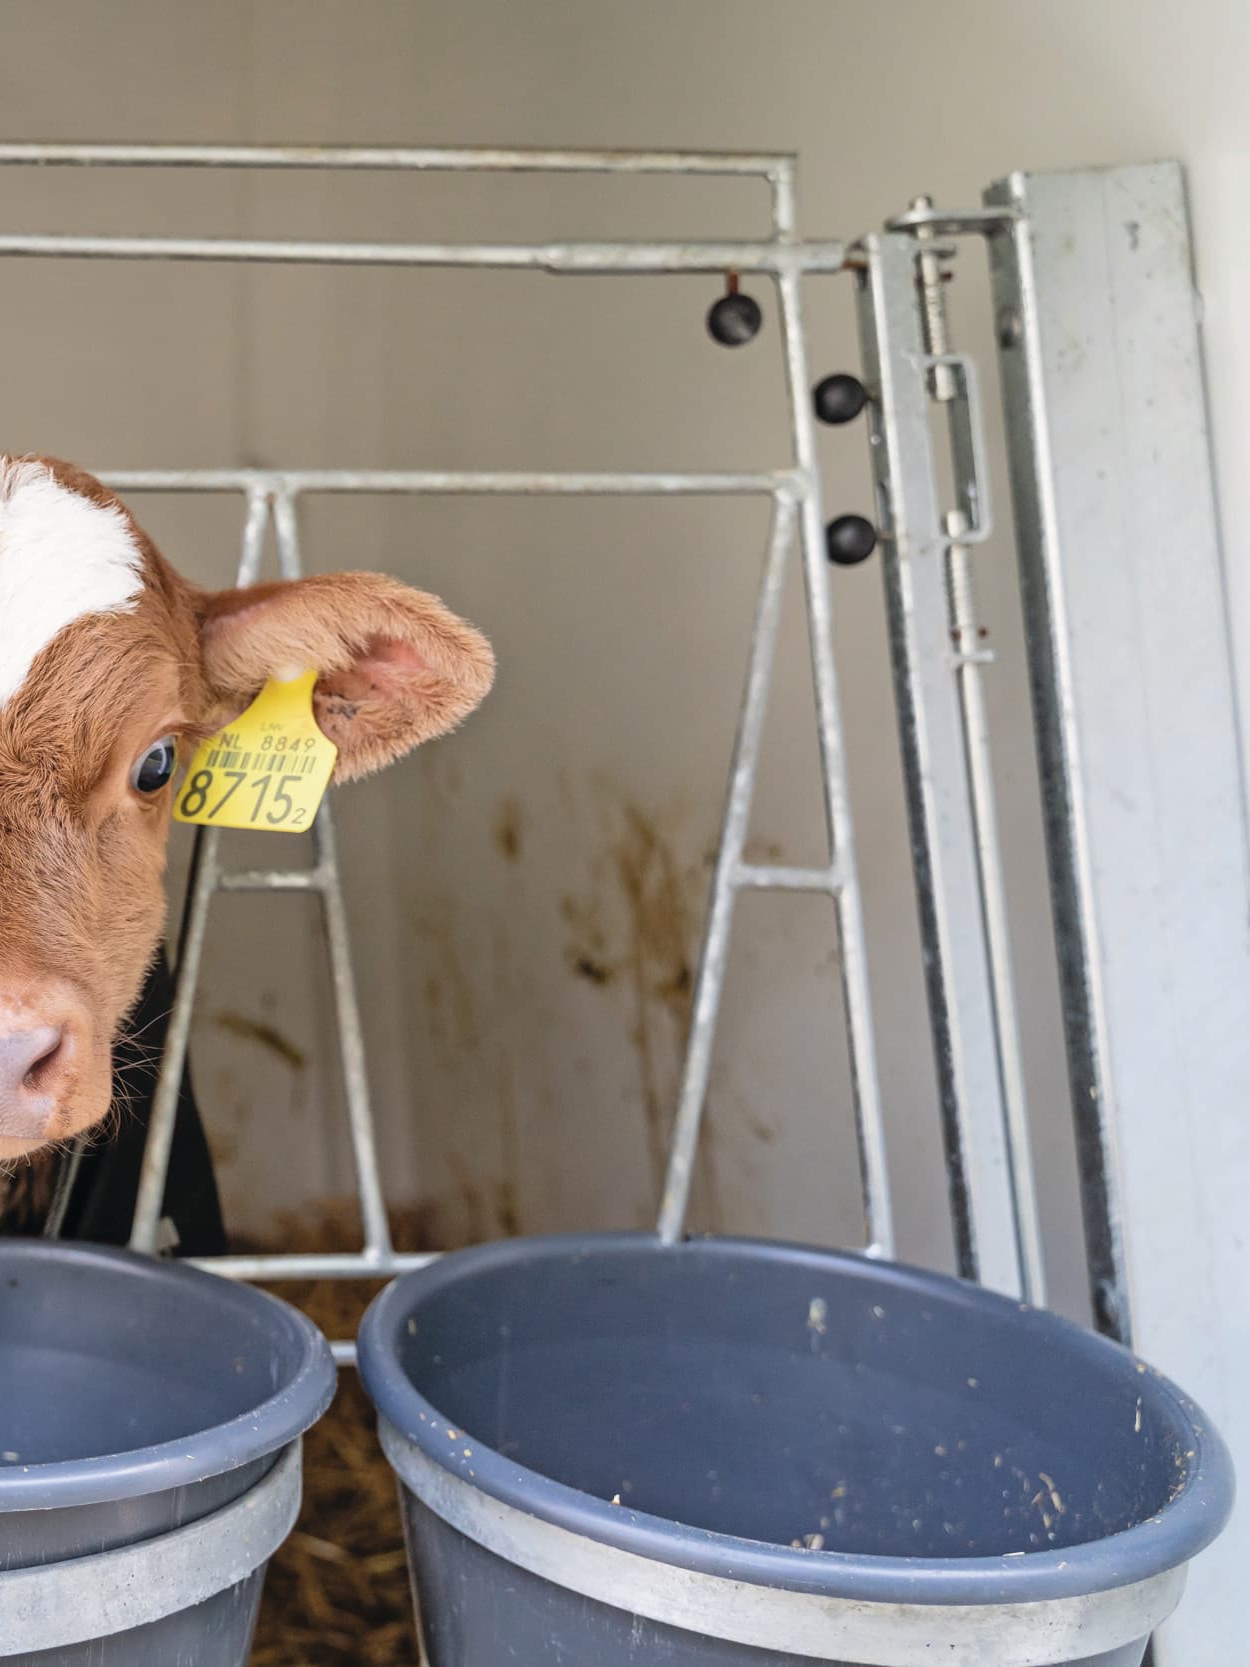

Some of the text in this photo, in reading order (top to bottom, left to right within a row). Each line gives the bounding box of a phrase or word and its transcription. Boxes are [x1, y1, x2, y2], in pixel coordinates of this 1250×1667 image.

[219, 732, 316, 752] NL 8849
[180, 769, 302, 825] 8715
